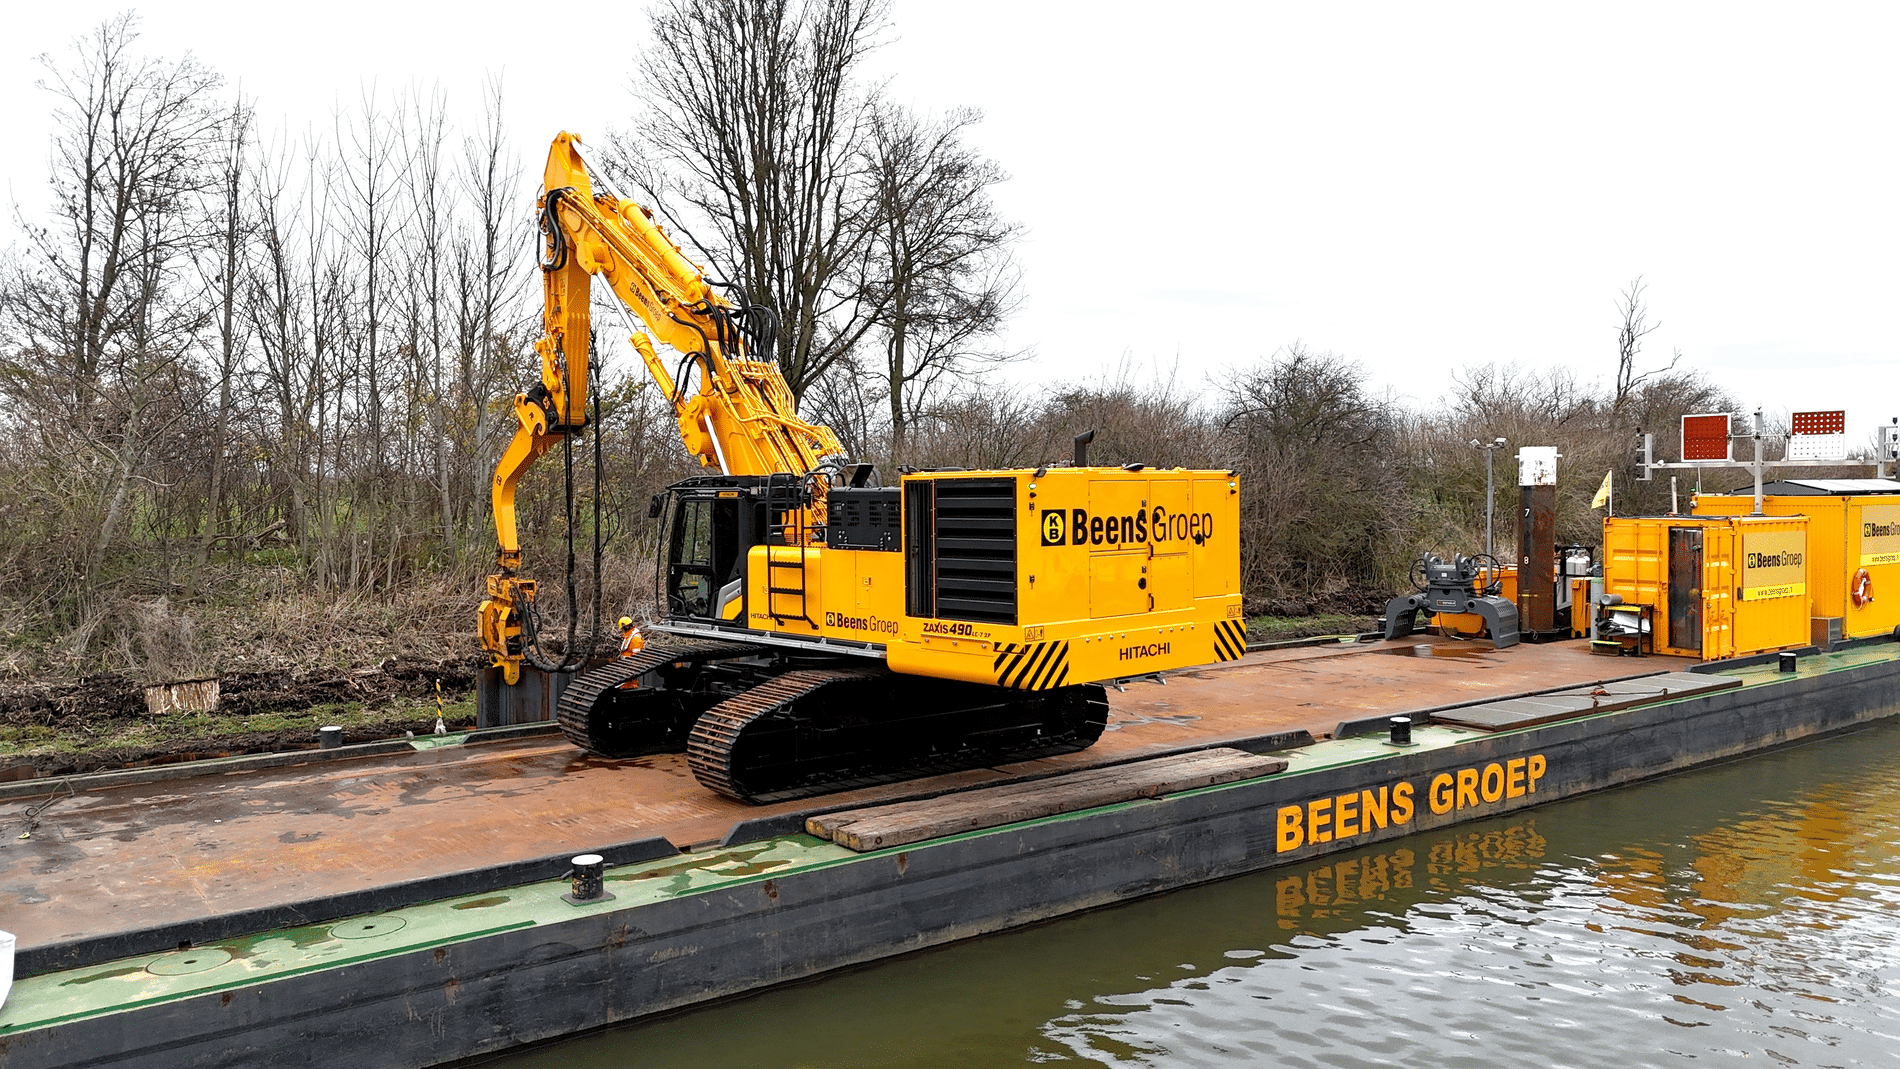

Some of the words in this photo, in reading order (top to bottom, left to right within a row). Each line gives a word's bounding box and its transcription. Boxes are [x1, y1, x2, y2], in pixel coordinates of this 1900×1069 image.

[1524, 508, 1530, 517] 7
[1072, 508, 1147, 545] Beens
[1152, 506, 1213, 547] Groep
[1871, 522, 1890, 537] Beens
[1523, 556, 1529, 565] 8
[1757, 552, 1780, 568] Beens
[1781, 550, 1802, 568] Groep
[837, 612, 868, 630] Beens
[869, 615, 899, 637] Groep
[923, 622, 948, 634] ZAXIS
[949, 623, 973, 636] 490
[1119, 642, 1170, 661] HITACHI
[1276, 781, 1415, 854] BEENS
[1429, 754, 1547, 815] GROEP
